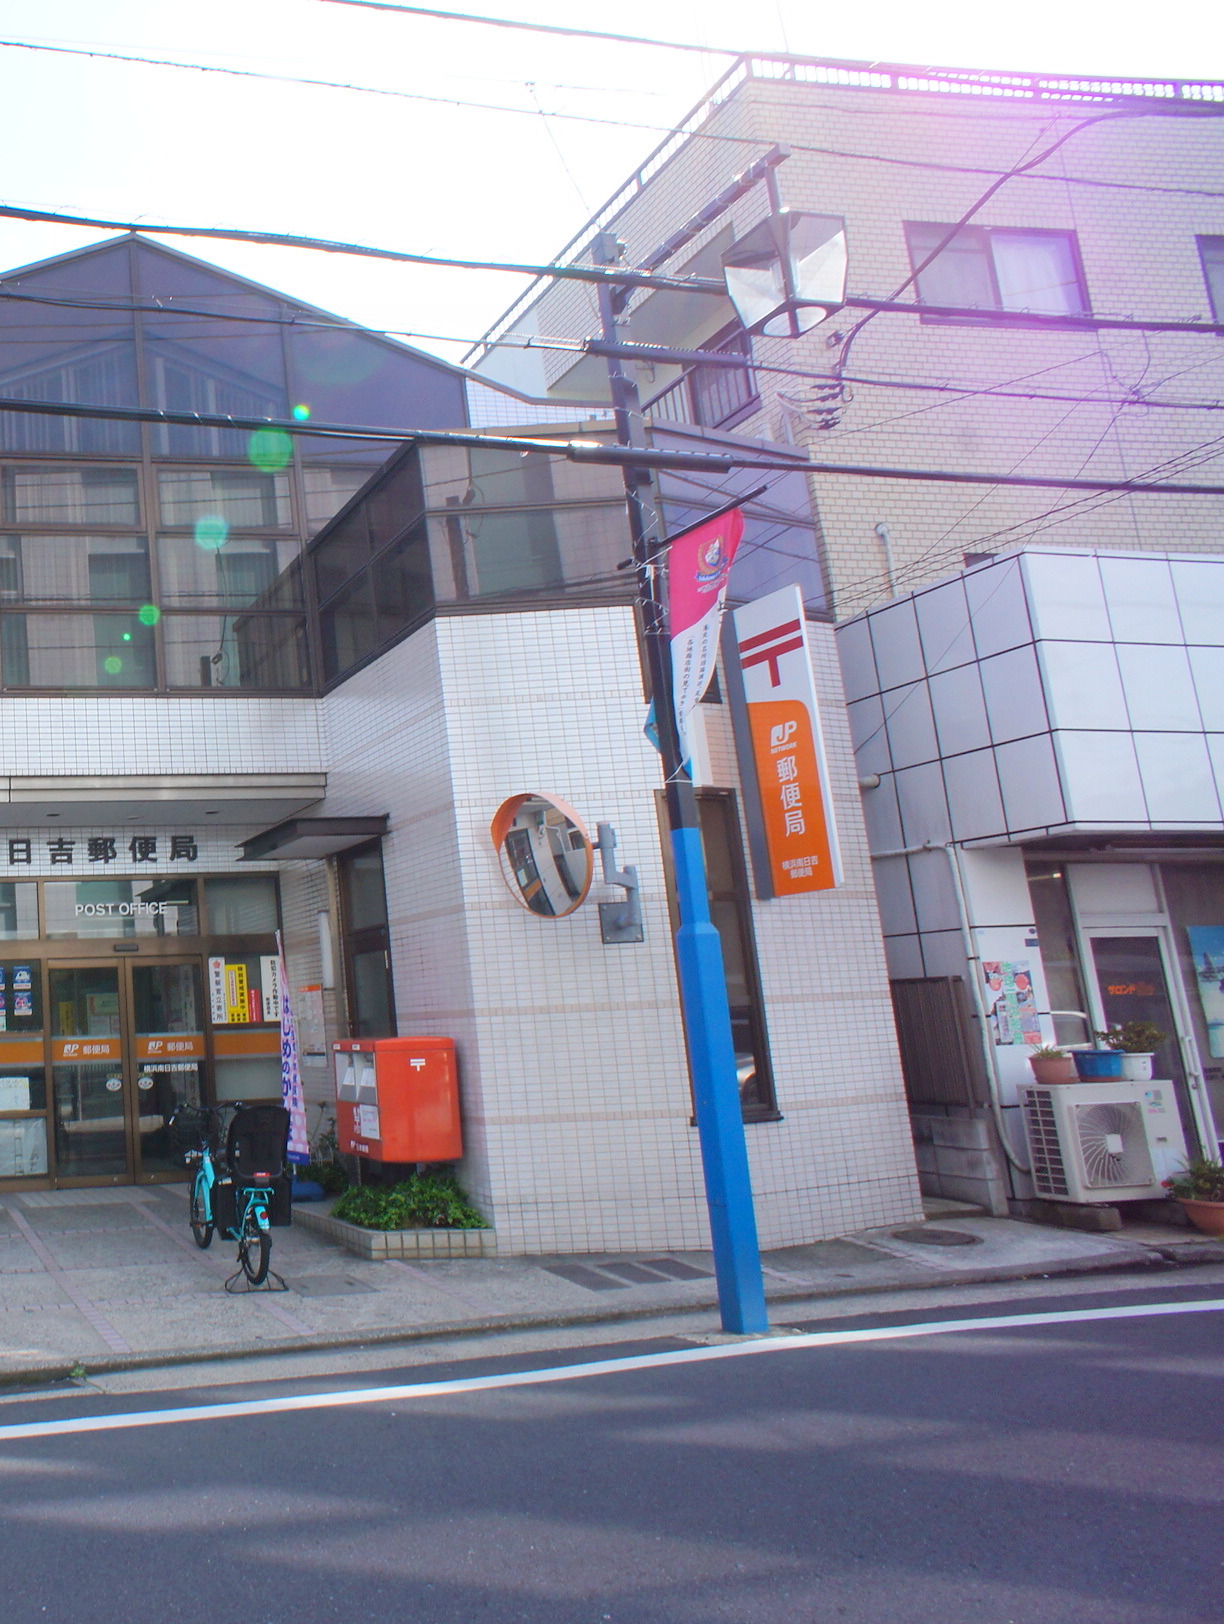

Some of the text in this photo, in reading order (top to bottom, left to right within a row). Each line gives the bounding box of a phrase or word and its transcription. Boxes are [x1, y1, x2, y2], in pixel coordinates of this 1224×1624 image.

[770, 741, 798, 754] NETWORK
[776, 755, 806, 837] 郵便局
[782, 855, 819, 871] 横浜南日吉
[790, 866, 813, 879] 郵便局
[74, 901, 168, 917] POST OFFICE
[143, 1062, 199, 1073] 横浜南日吉郵便局
